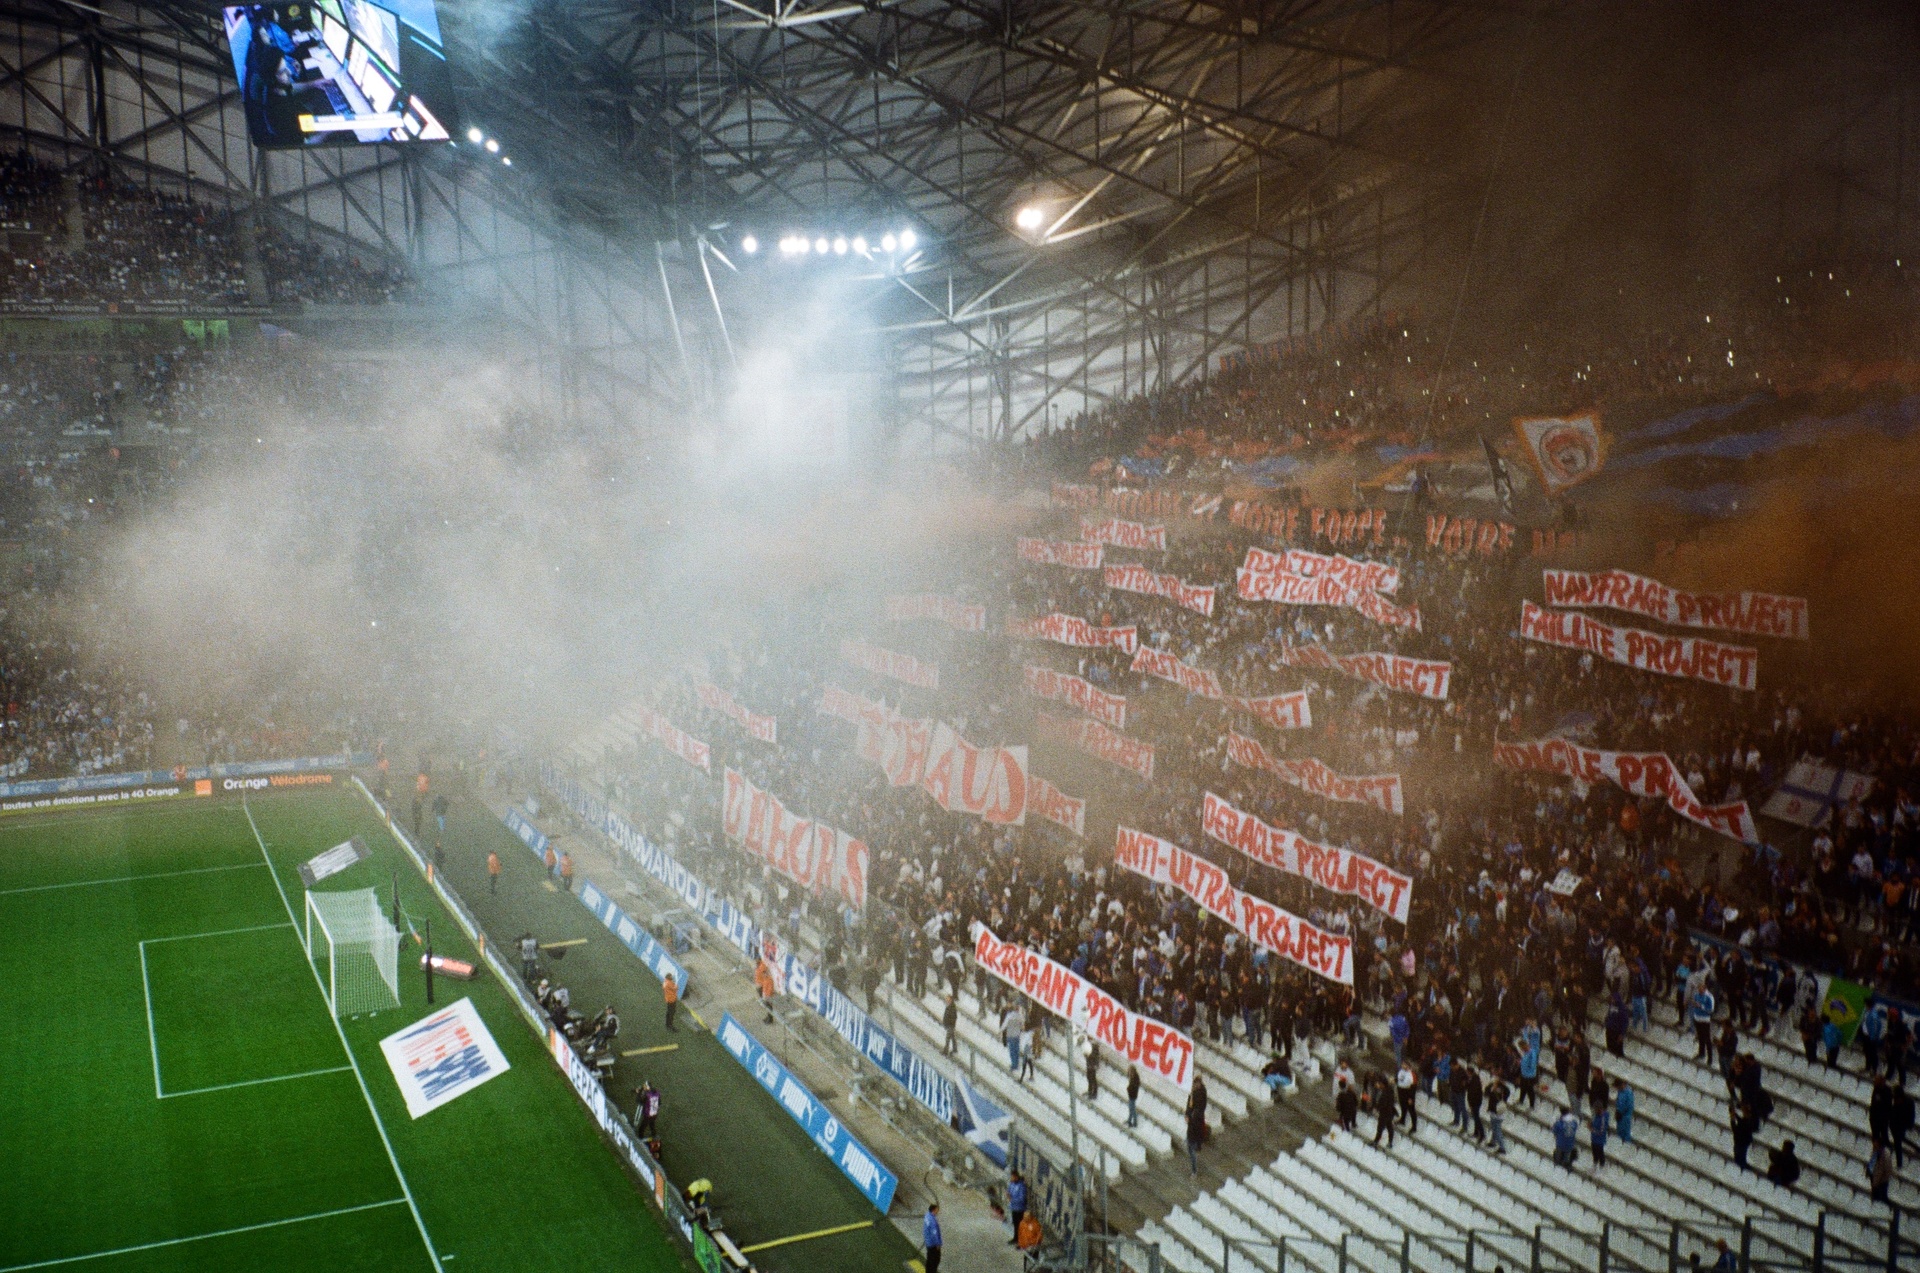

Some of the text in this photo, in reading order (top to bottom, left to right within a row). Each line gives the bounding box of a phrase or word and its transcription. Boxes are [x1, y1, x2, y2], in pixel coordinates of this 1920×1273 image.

[1115, 519, 1166, 551] PROT
[1158, 574, 1216, 615] PRECT
[1545, 571, 1806, 636] NAUFRAGE PROJECT
[1337, 655, 1449, 697] PROJECT
[1521, 603, 1757, 689] FAILLITE PROJECT
[2, 787, 180, 811] toutes vos émotions avec la 4G Orange
[223, 773, 333, 790] Orange Vélodrome
[1615, 753, 1746, 839] PRJT
[725, 770, 870, 909] DEHORS
[1203, 795, 1408, 917] DEBACLE PROJECT
[1115, 829, 1351, 977] ANTI-ULTRAS PROJECT
[789, 955, 821, 1010] 84
[976, 929, 1193, 1085] ARROGANT PROJECT
